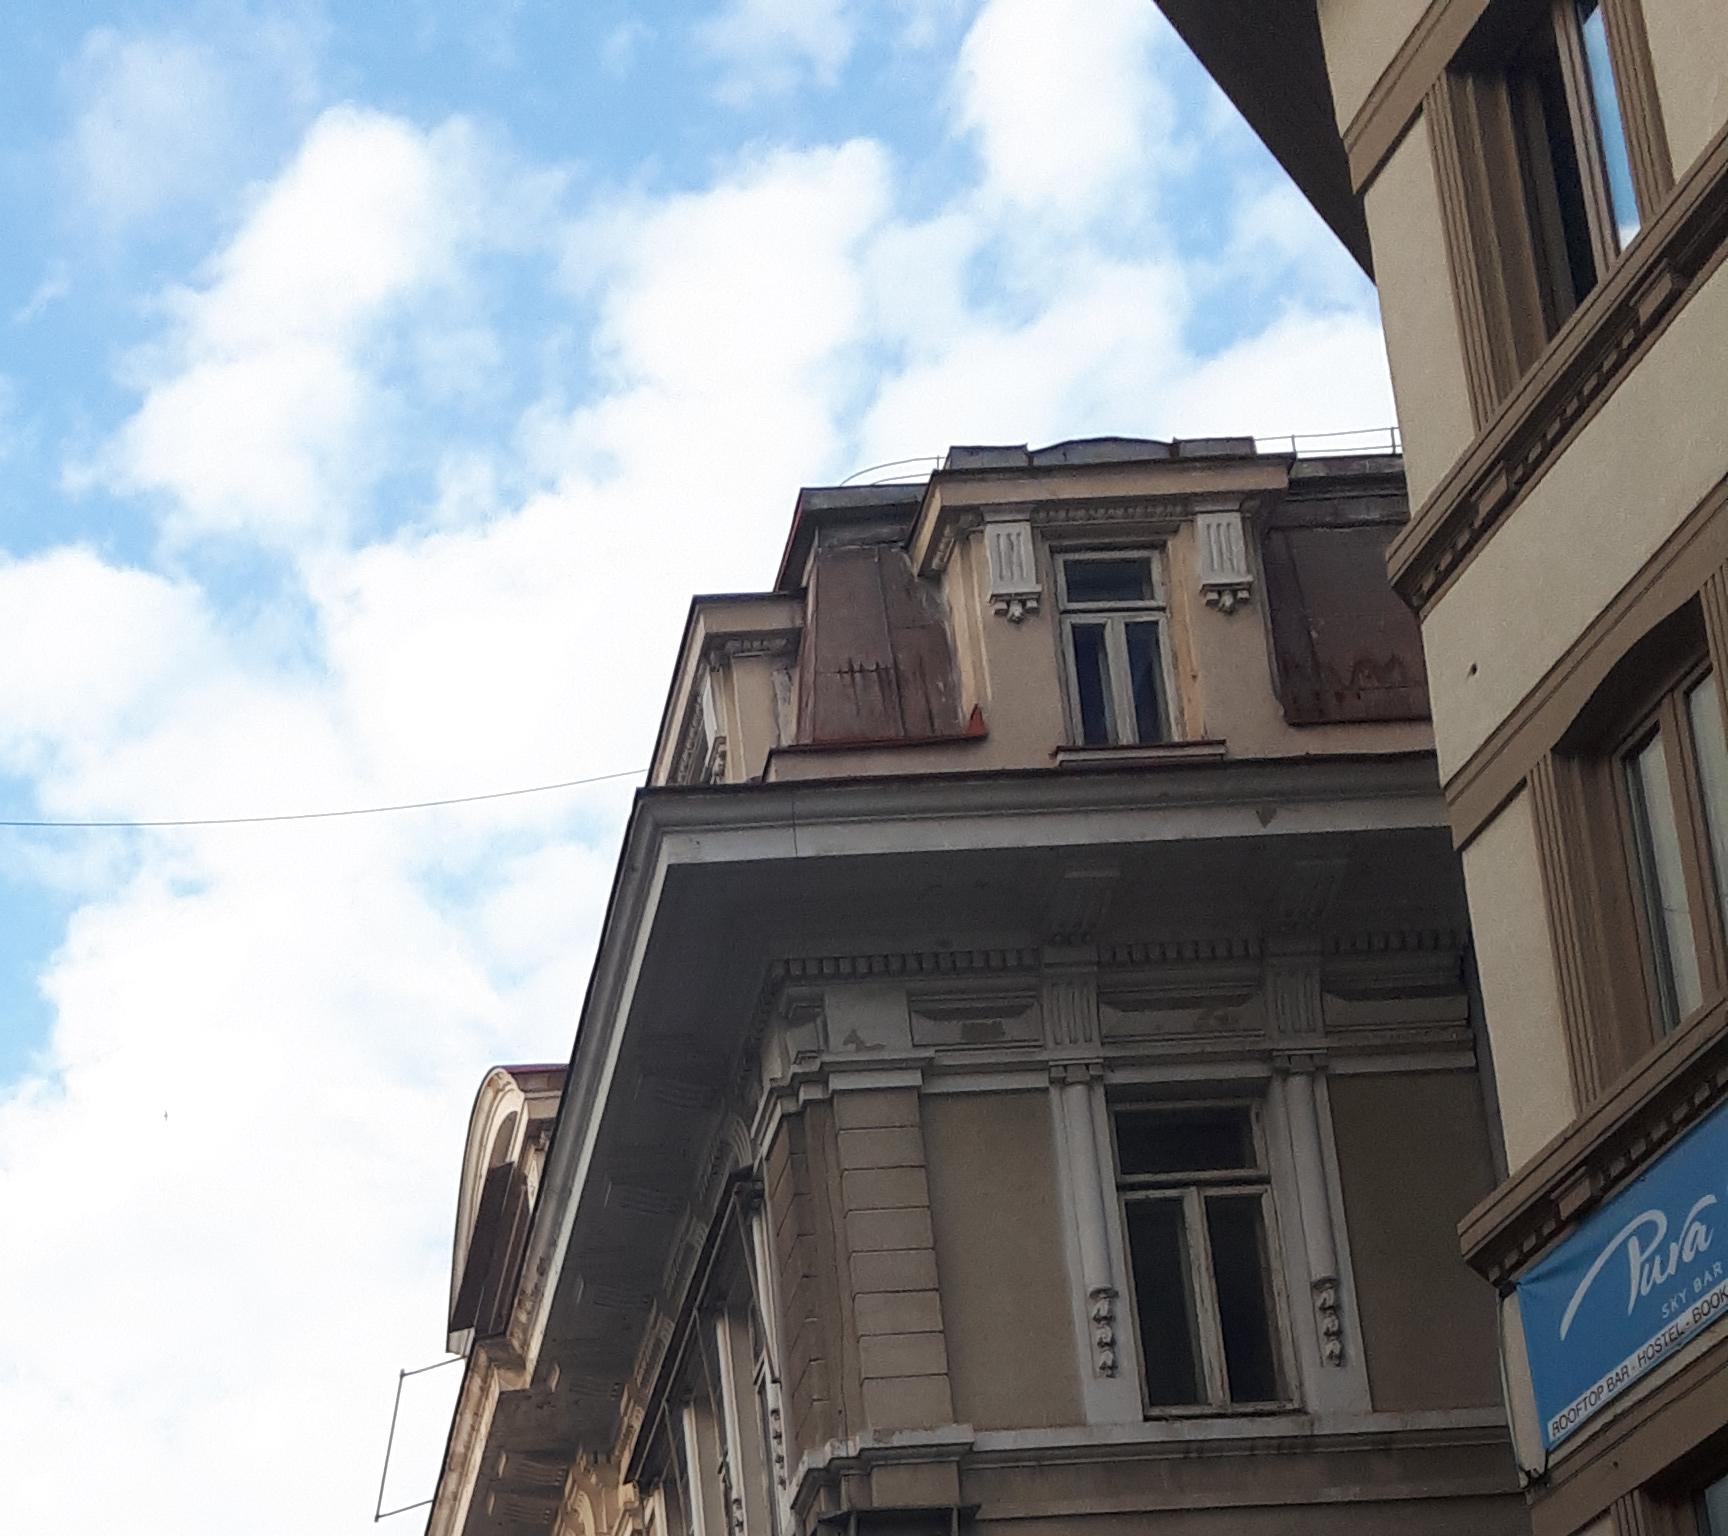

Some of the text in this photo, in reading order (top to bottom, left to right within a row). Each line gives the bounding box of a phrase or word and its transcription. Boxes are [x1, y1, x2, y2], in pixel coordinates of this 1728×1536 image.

[1559, 1193, 1719, 1342] Pura
[1660, 1261, 1724, 1321] SKY BAR
[1551, 1384, 1606, 1436] ROOFTOP
[1606, 1364, 1631, 1394] BAR
[1636, 1323, 1685, 1367] HOSTEL
